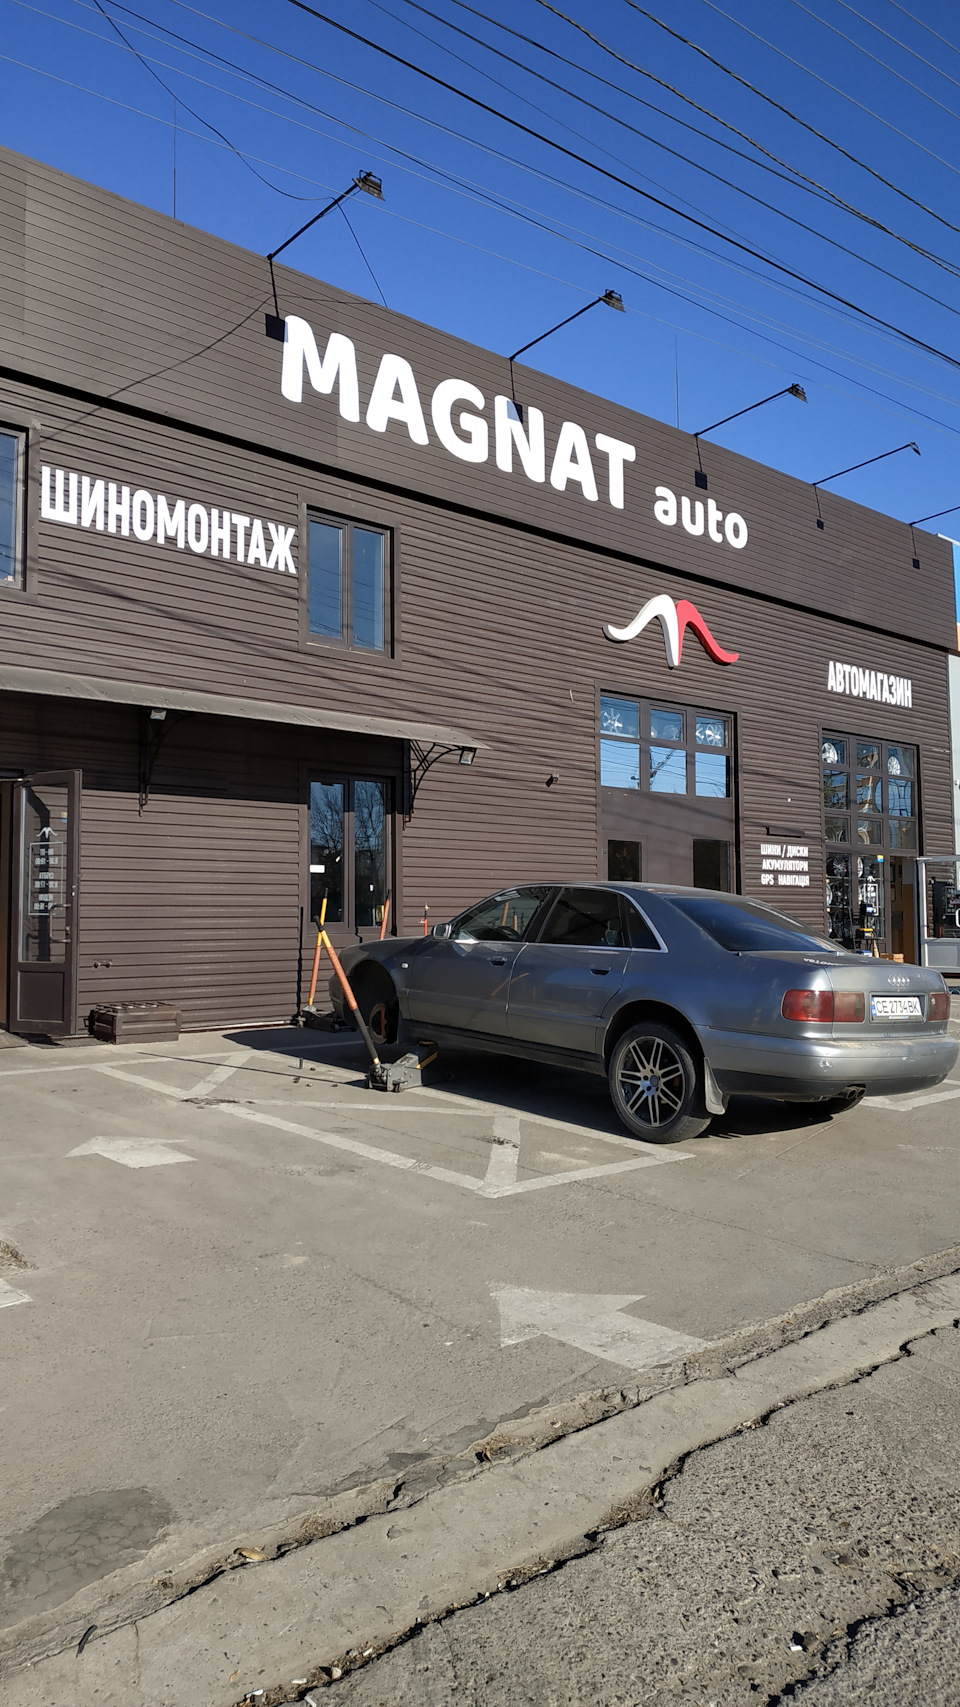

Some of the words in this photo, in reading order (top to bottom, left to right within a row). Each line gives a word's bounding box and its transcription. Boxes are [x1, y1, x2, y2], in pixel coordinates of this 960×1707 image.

[281, 314, 636, 510] MAGNAT
[653, 486, 749, 550] auto
[40, 465, 297, 574] ШИНОМОНТАЖ
[827, 660, 912, 708] АВТОМАГАЗИН
[760, 843, 782, 856] ШИНИ
[786, 845, 809, 858] ДИСКИ
[762, 859, 809, 872] АКУМУЛЯТОРИ
[761, 873, 775, 886] GPS
[778, 874, 810, 888] НАВІГАЦІЯ
